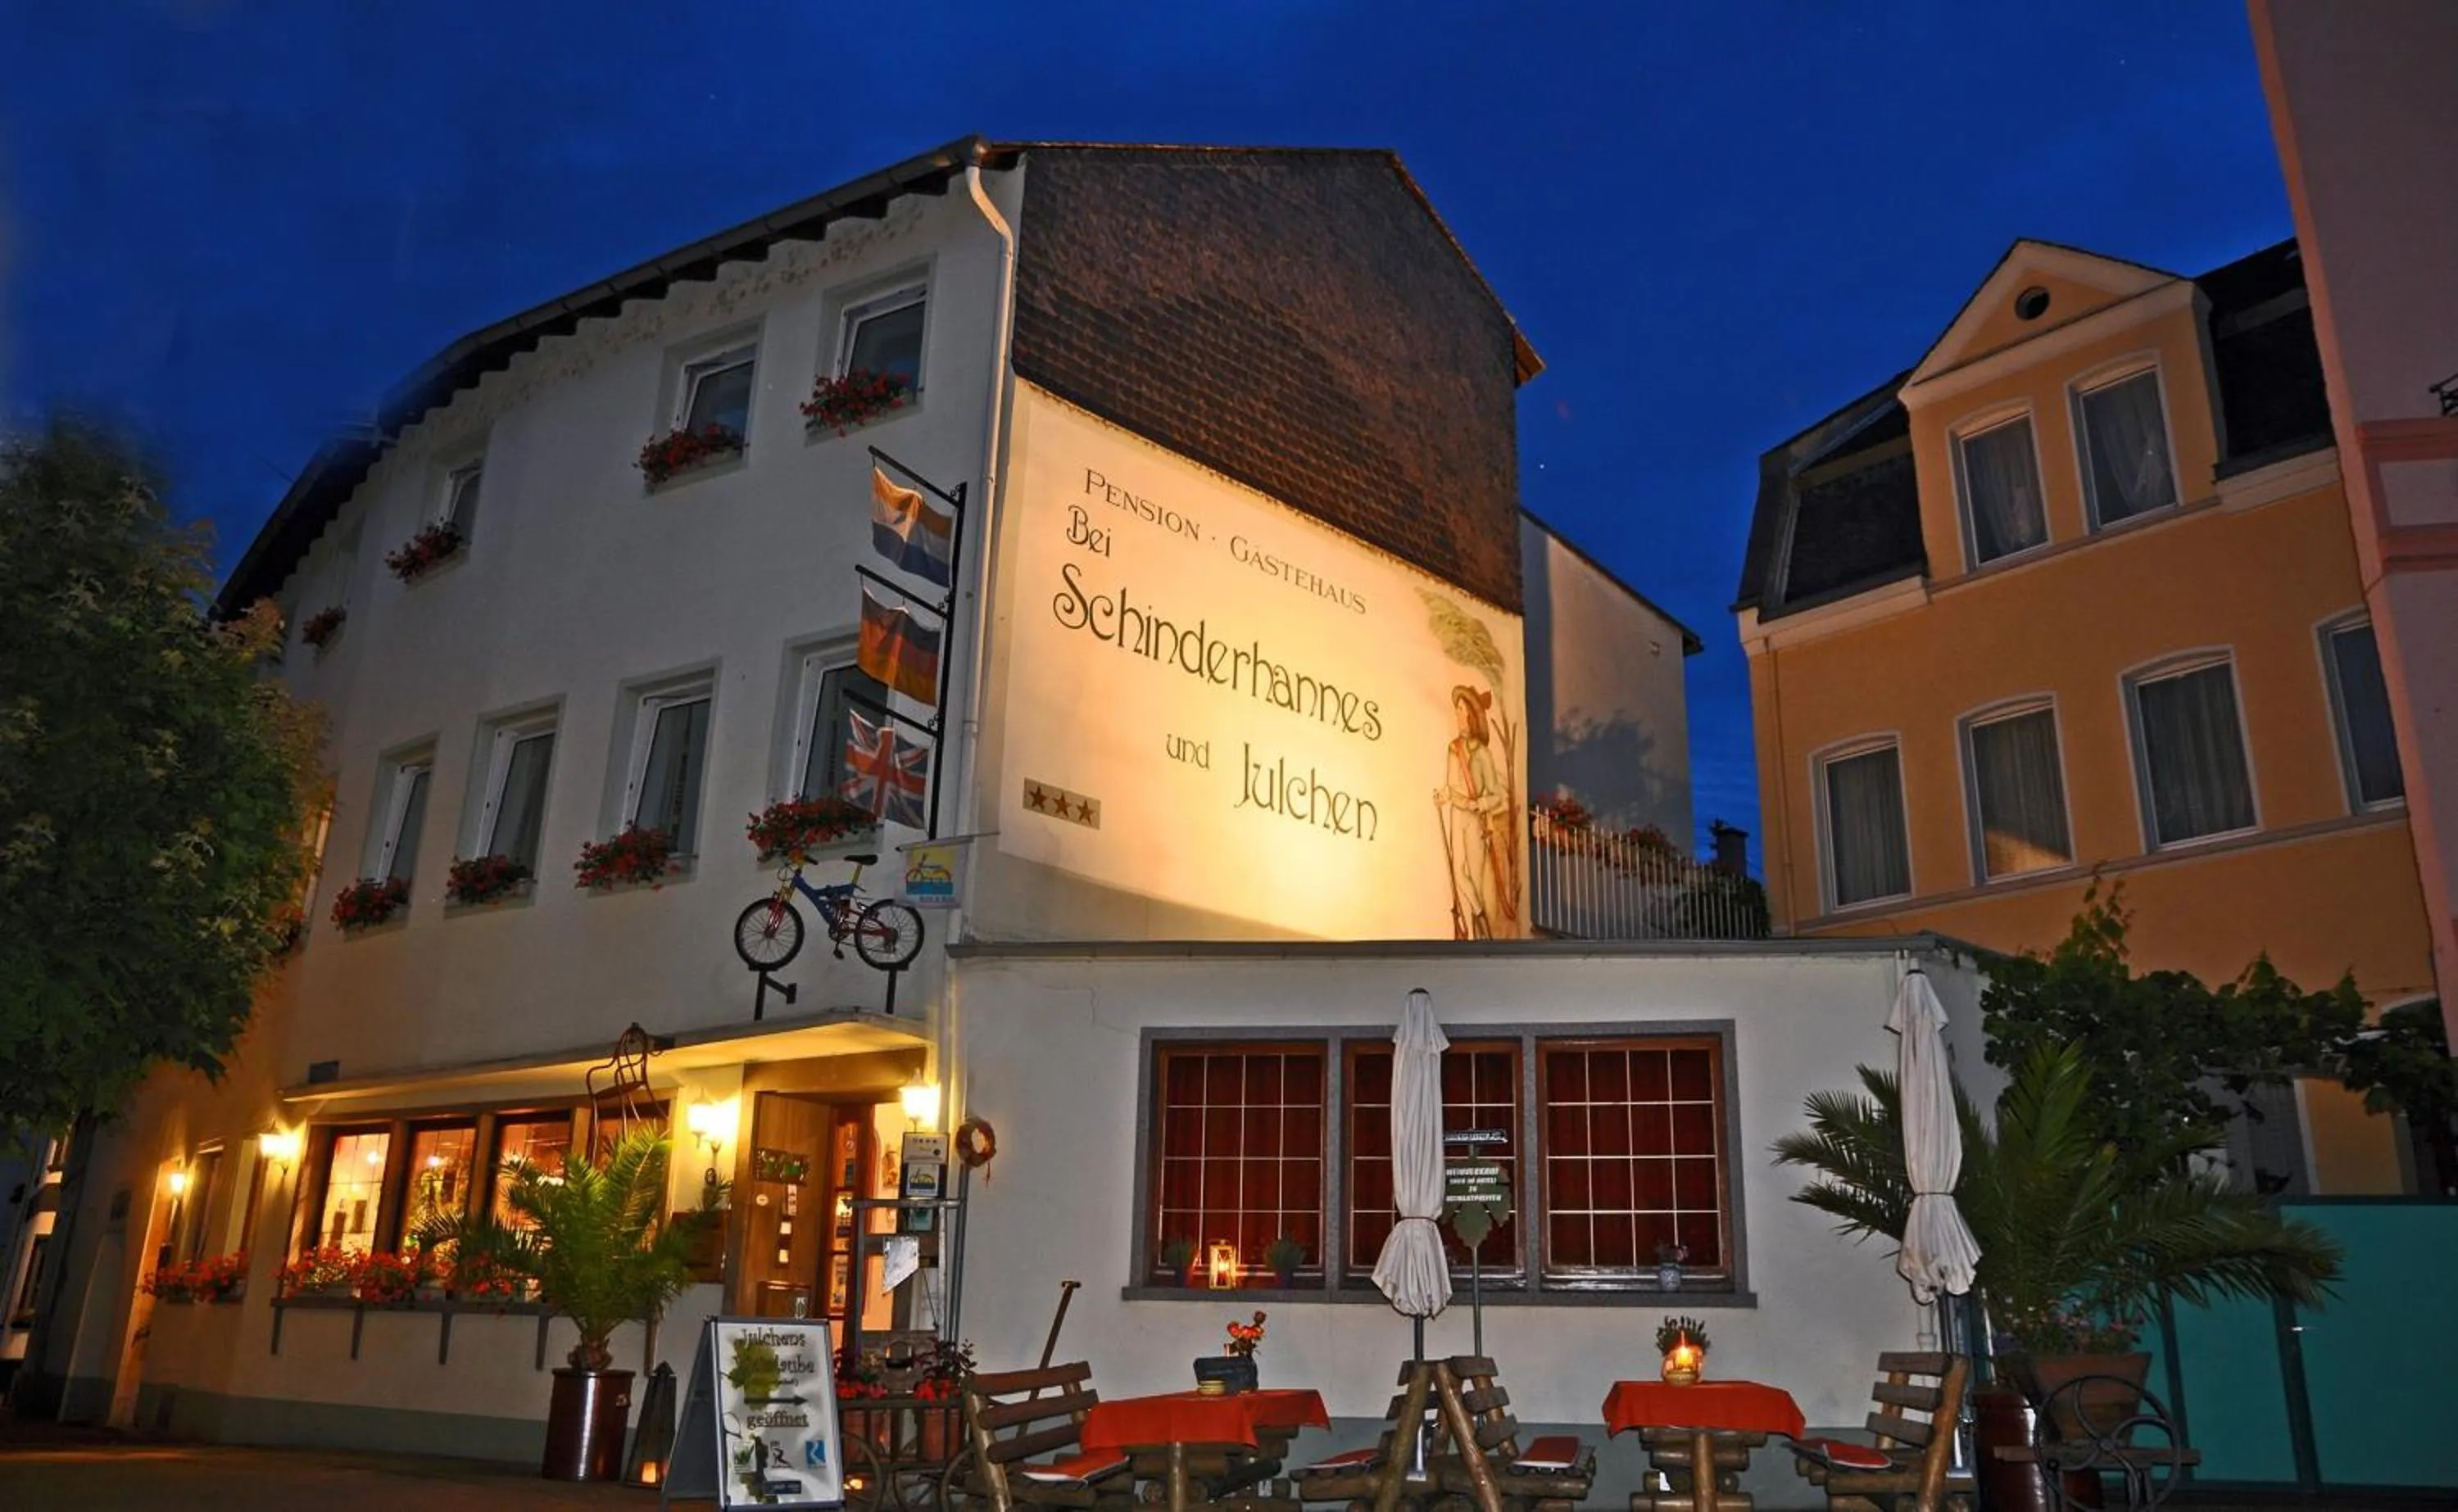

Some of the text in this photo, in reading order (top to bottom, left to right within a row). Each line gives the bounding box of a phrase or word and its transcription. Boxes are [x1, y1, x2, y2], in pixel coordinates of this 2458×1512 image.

[1067, 505, 1111, 558] Bei
[1085, 468, 1200, 541] PENSION
[1053, 563, 1381, 740] Schinderhannes
[1166, 734, 1377, 840] und Julchen
[746, 1410, 810, 1430] geöffnet
